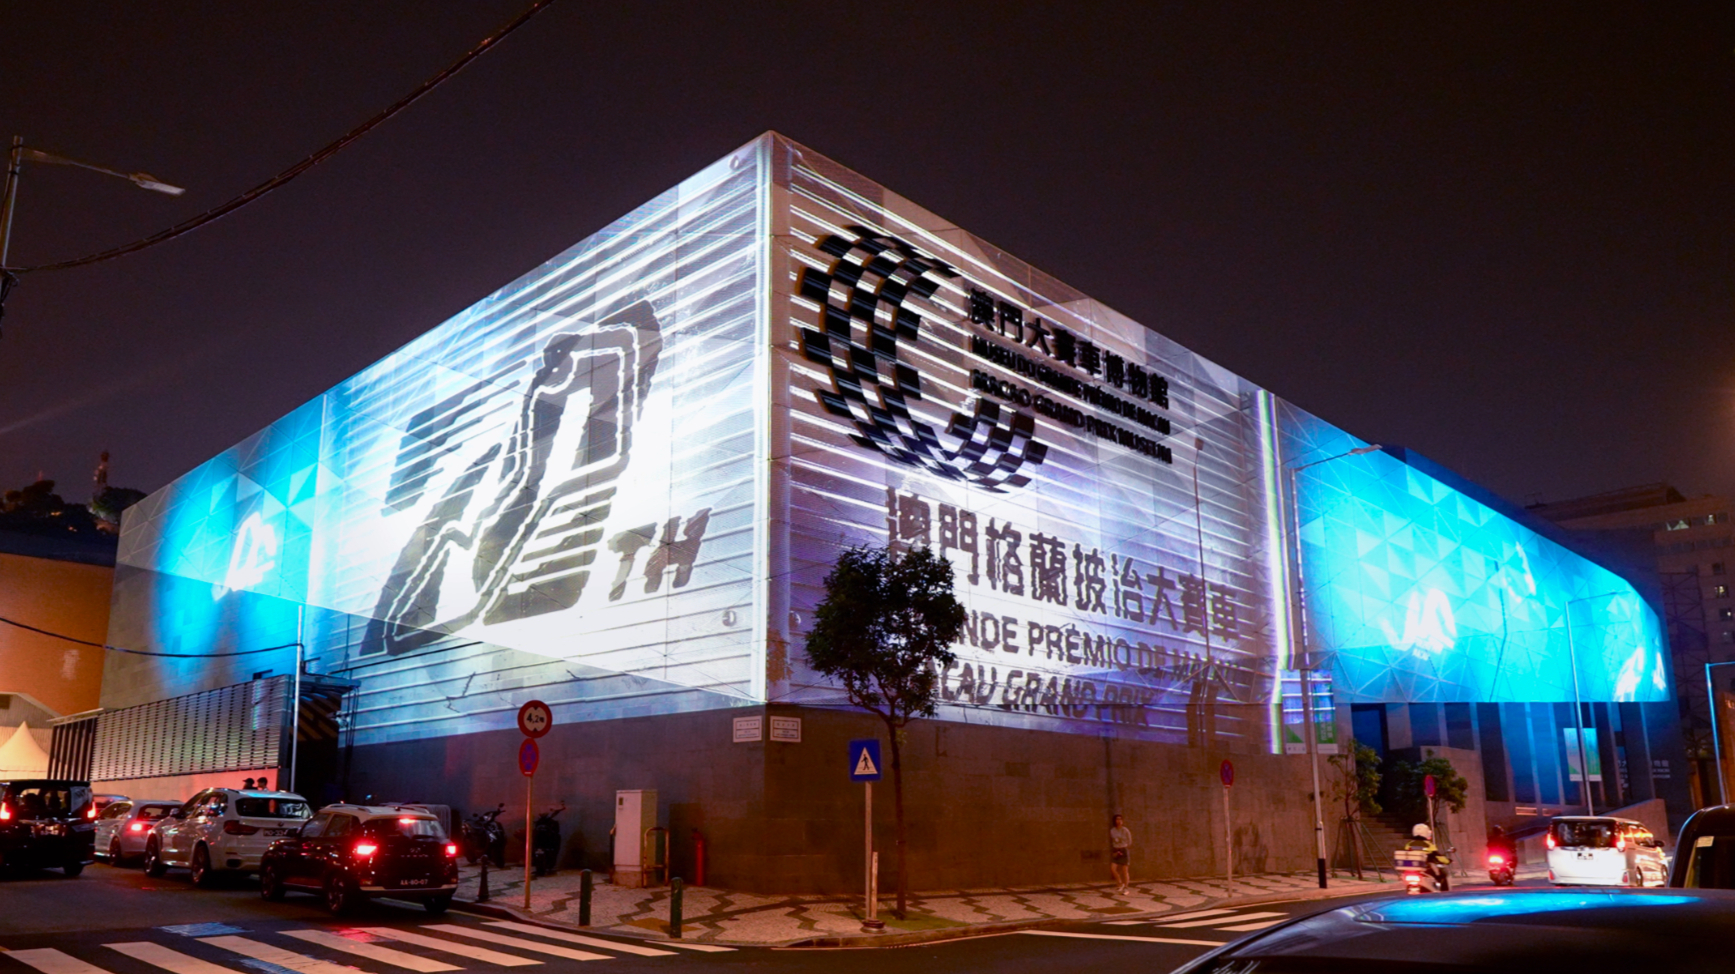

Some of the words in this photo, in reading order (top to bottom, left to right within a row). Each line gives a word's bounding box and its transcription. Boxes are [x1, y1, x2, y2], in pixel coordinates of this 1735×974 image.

[970, 288, 1169, 410] 澳門大賽車博物館
[1032, 394, 1086, 429] GRAND
[1117, 428, 1173, 465] MUSEUM
[1002, 670, 1098, 719] GRAND
